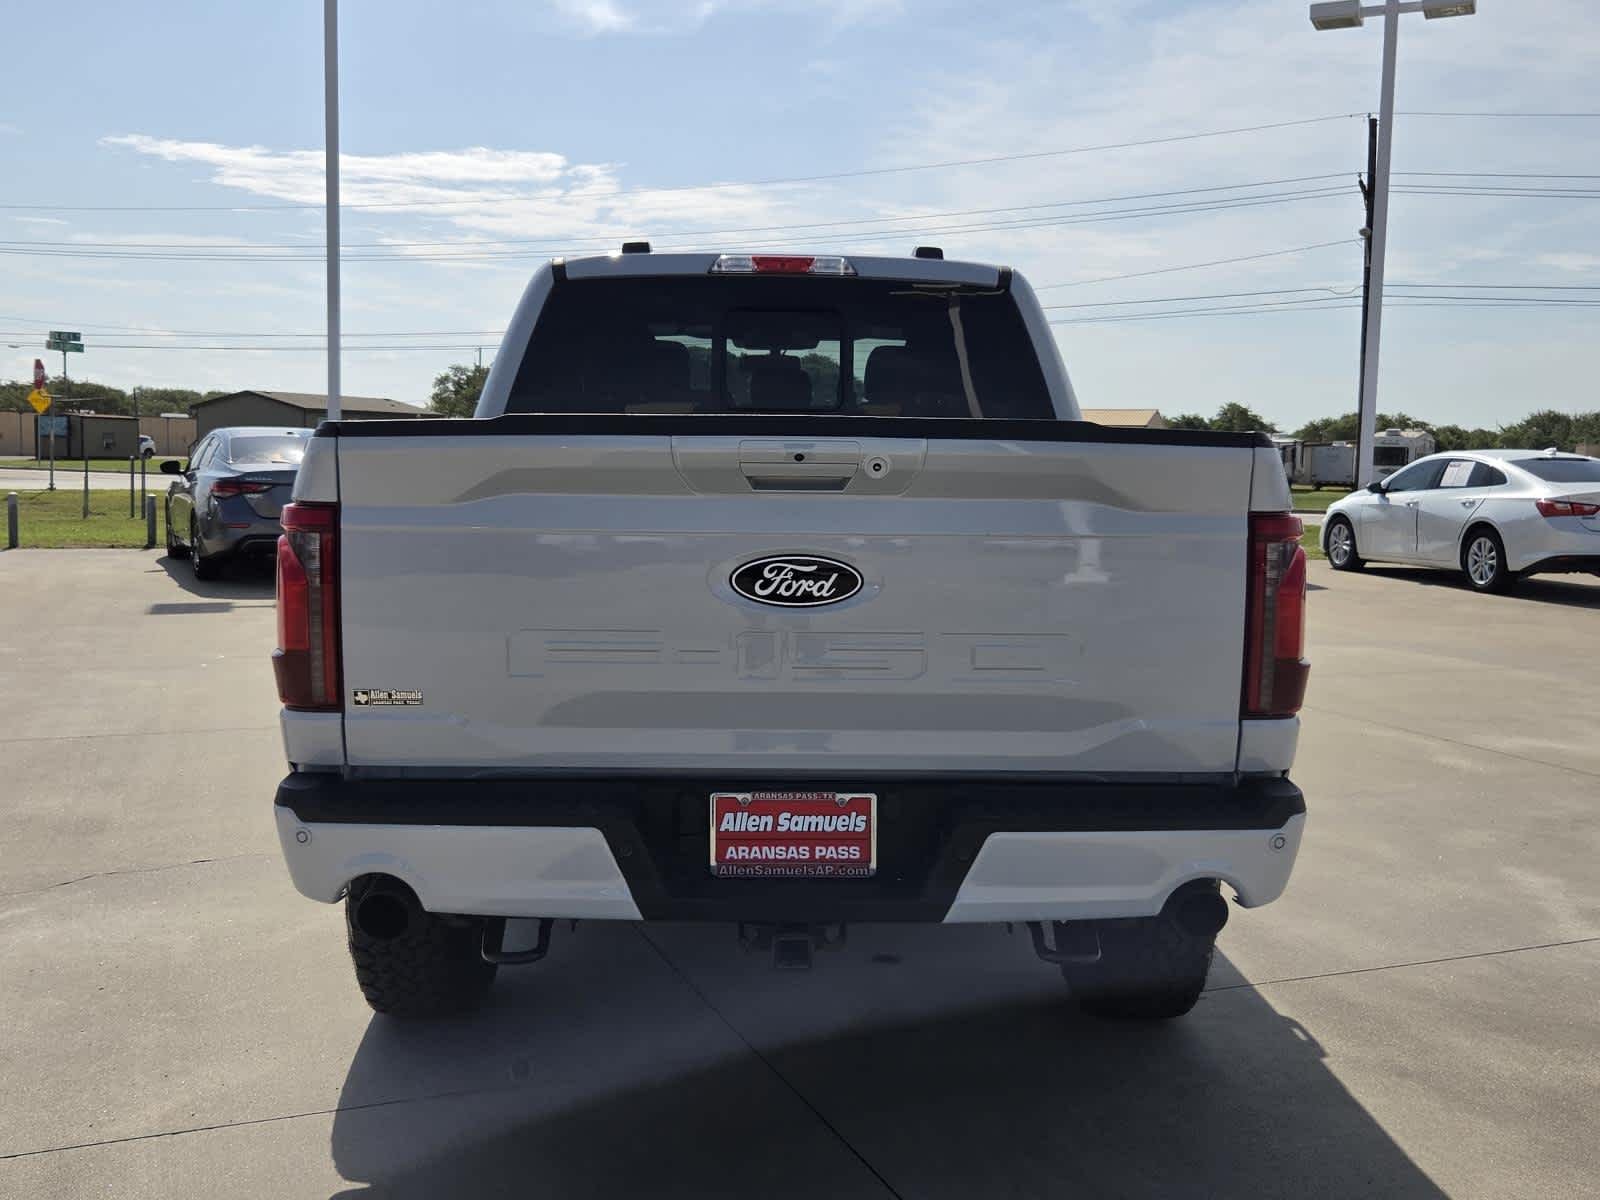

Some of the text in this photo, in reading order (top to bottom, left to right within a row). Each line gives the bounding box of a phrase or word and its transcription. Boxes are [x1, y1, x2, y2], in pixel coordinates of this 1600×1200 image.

[754, 562, 839, 597] Ford
[370, 689, 422, 699] Allen Samuels
[719, 811, 867, 832] Allen Samuels
[725, 846, 861, 860] ARANSAS PASS
[719, 864, 869, 876] AllenSamuelsAP.com
